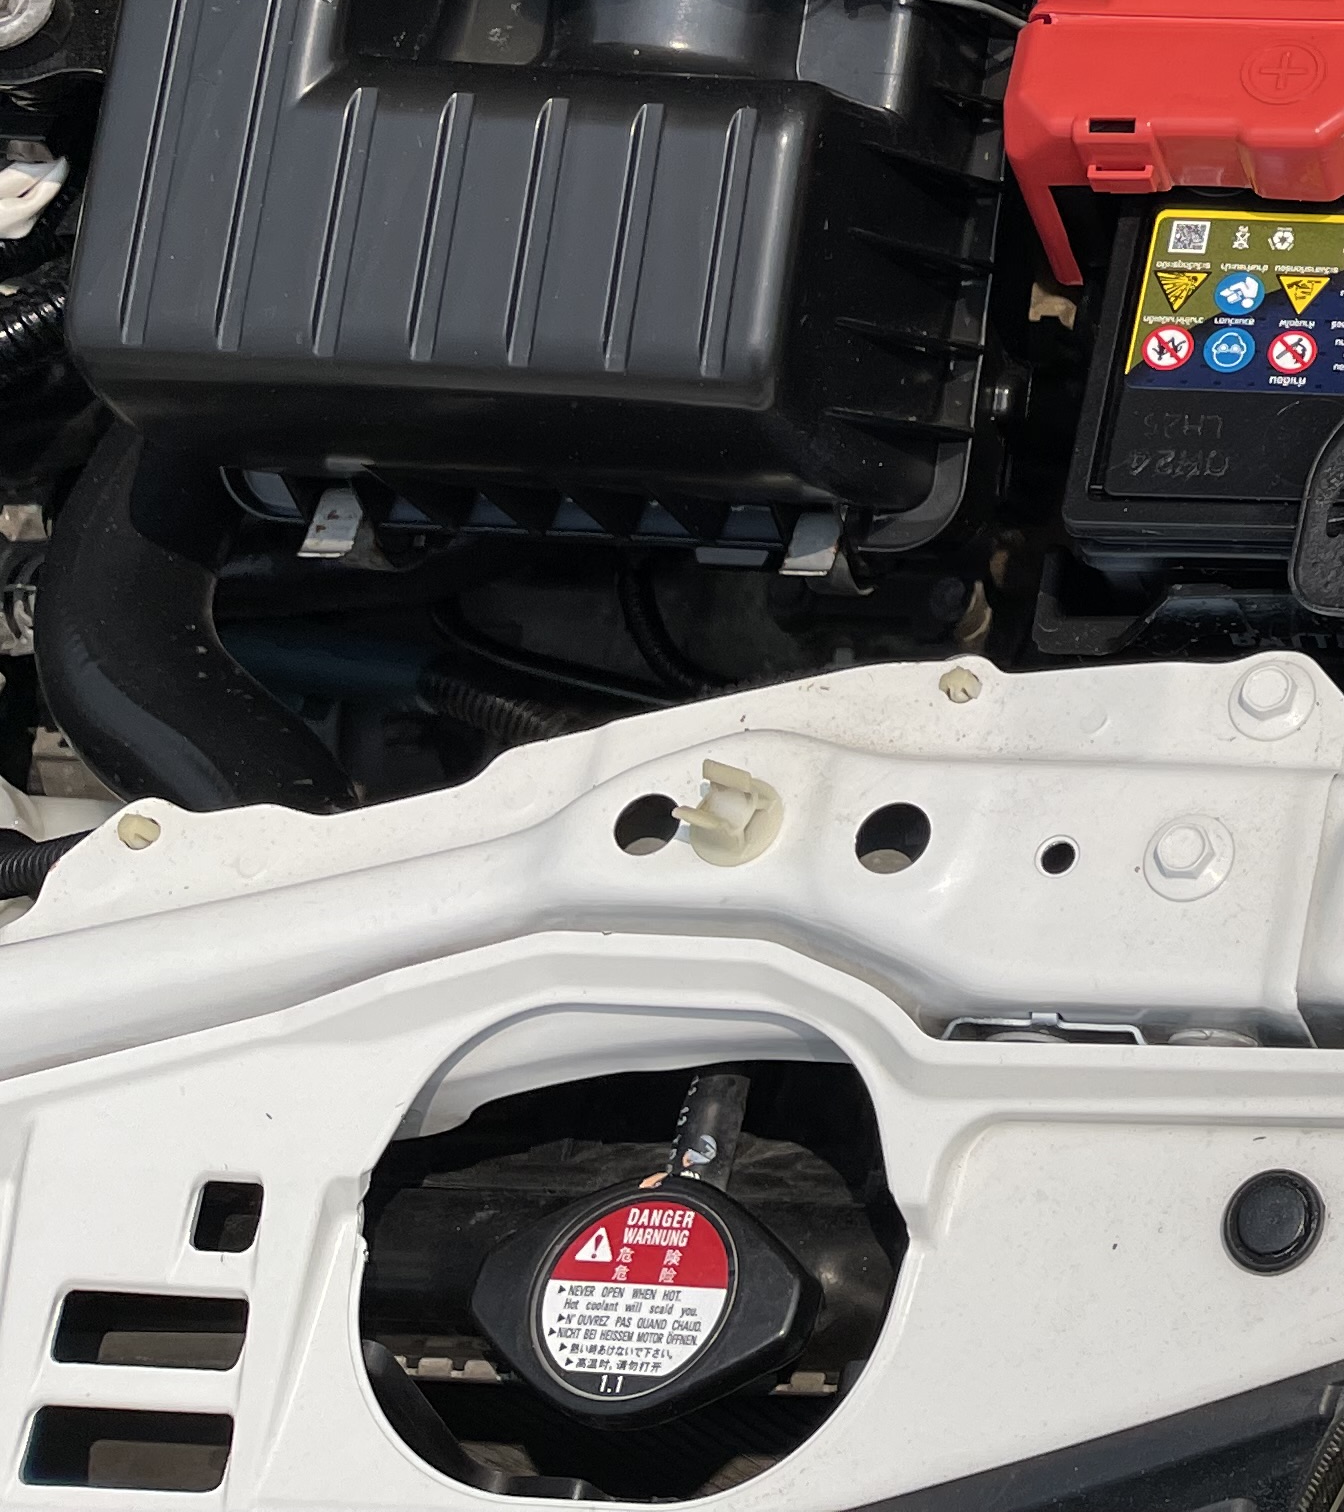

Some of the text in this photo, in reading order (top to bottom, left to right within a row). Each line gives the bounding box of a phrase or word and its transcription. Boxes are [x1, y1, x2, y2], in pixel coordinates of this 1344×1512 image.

[1269, 376, 1306, 387] คำเตือน
[627, 1208, 696, 1228] DANGER
[623, 1228, 690, 1247] WARNUNG
[568, 1285, 595, 1296] NEVER
[601, 1286, 625, 1298] OPEN
[632, 1288, 657, 1300] WHEN
[564, 1298, 579, 1309] Hot
[586, 1300, 619, 1312] coolant
[625, 1301, 642, 1312] will
[680, 1307, 697, 1318] you.
[615, 1316, 632, 1328] PAS
[557, 1327, 581, 1339] NICHT
[583, 1329, 597, 1339] BEI
[600, 1329, 634, 1341] HEISSEM
[636, 1332, 664, 1343] MOTOR
[600, 1374, 623, 1393] 1.1
